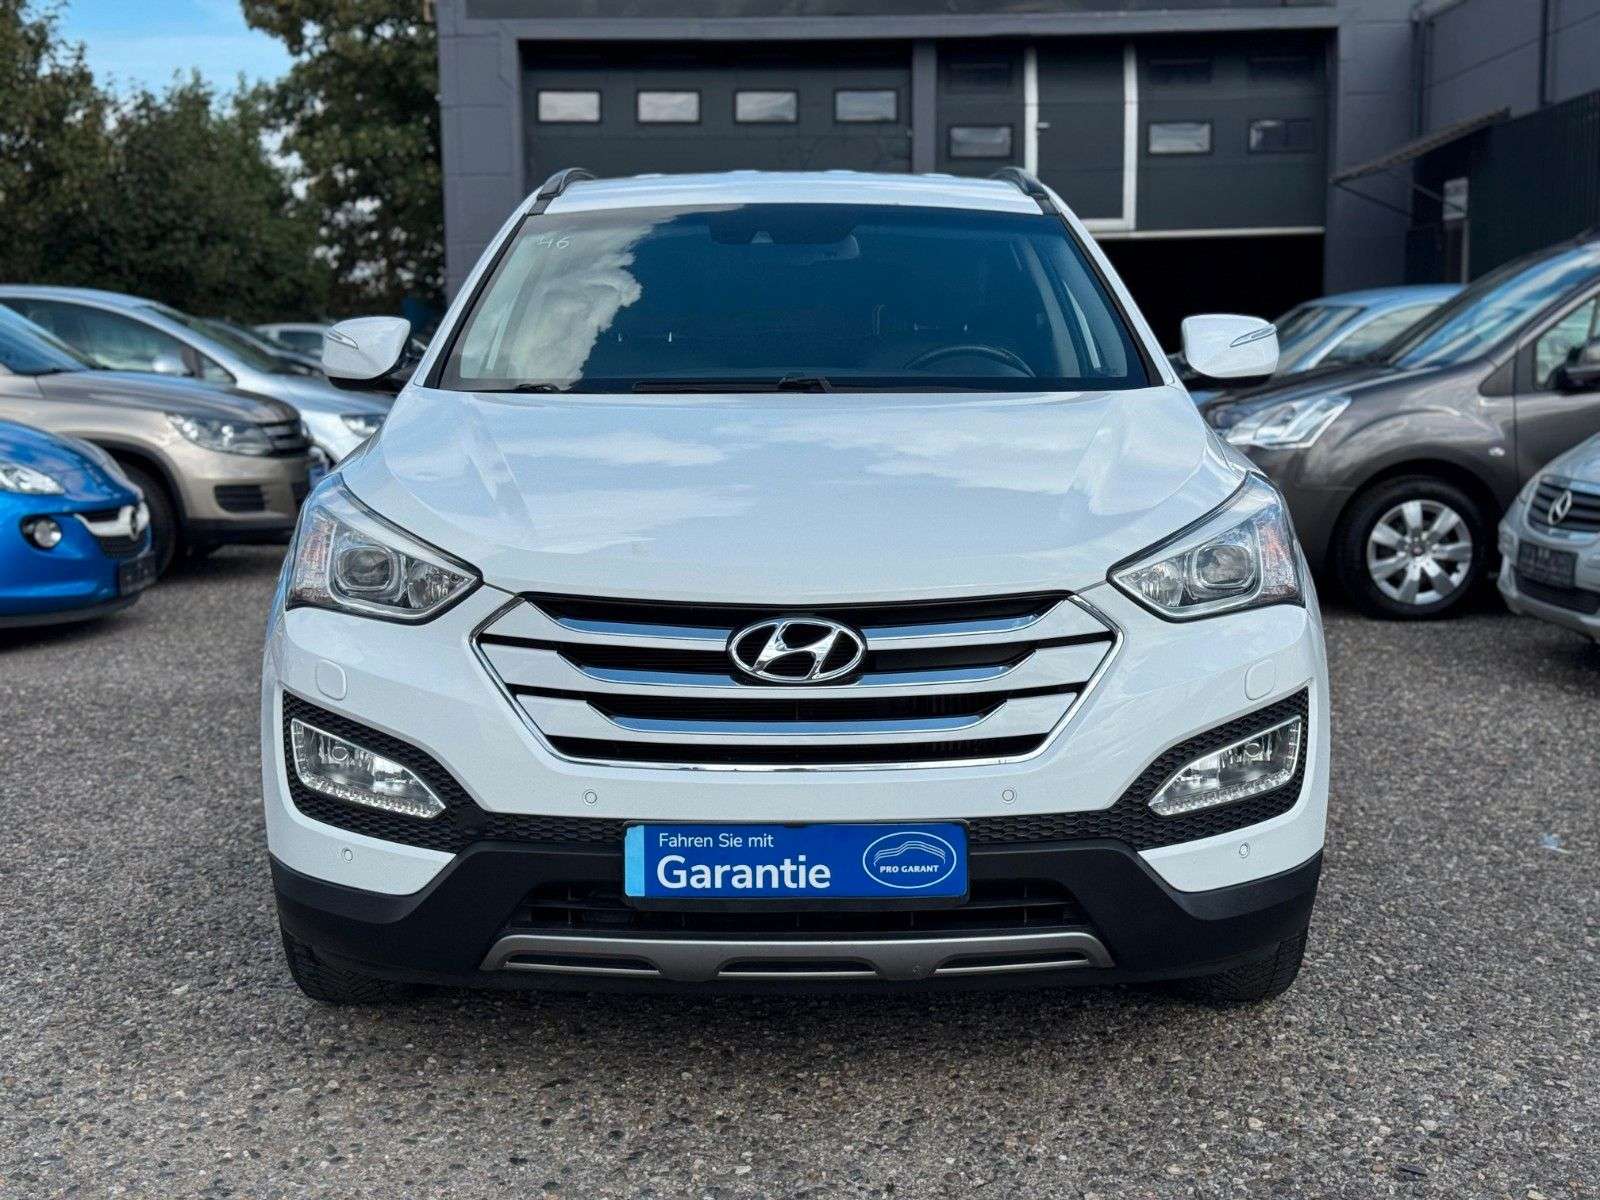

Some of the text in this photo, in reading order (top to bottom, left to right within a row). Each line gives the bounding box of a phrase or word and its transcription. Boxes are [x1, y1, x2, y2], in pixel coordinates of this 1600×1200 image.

[658, 832, 774, 848] Fahren Sie mit
[656, 854, 831, 889] Garantie
[879, 864, 939, 873] PRO GARANT
